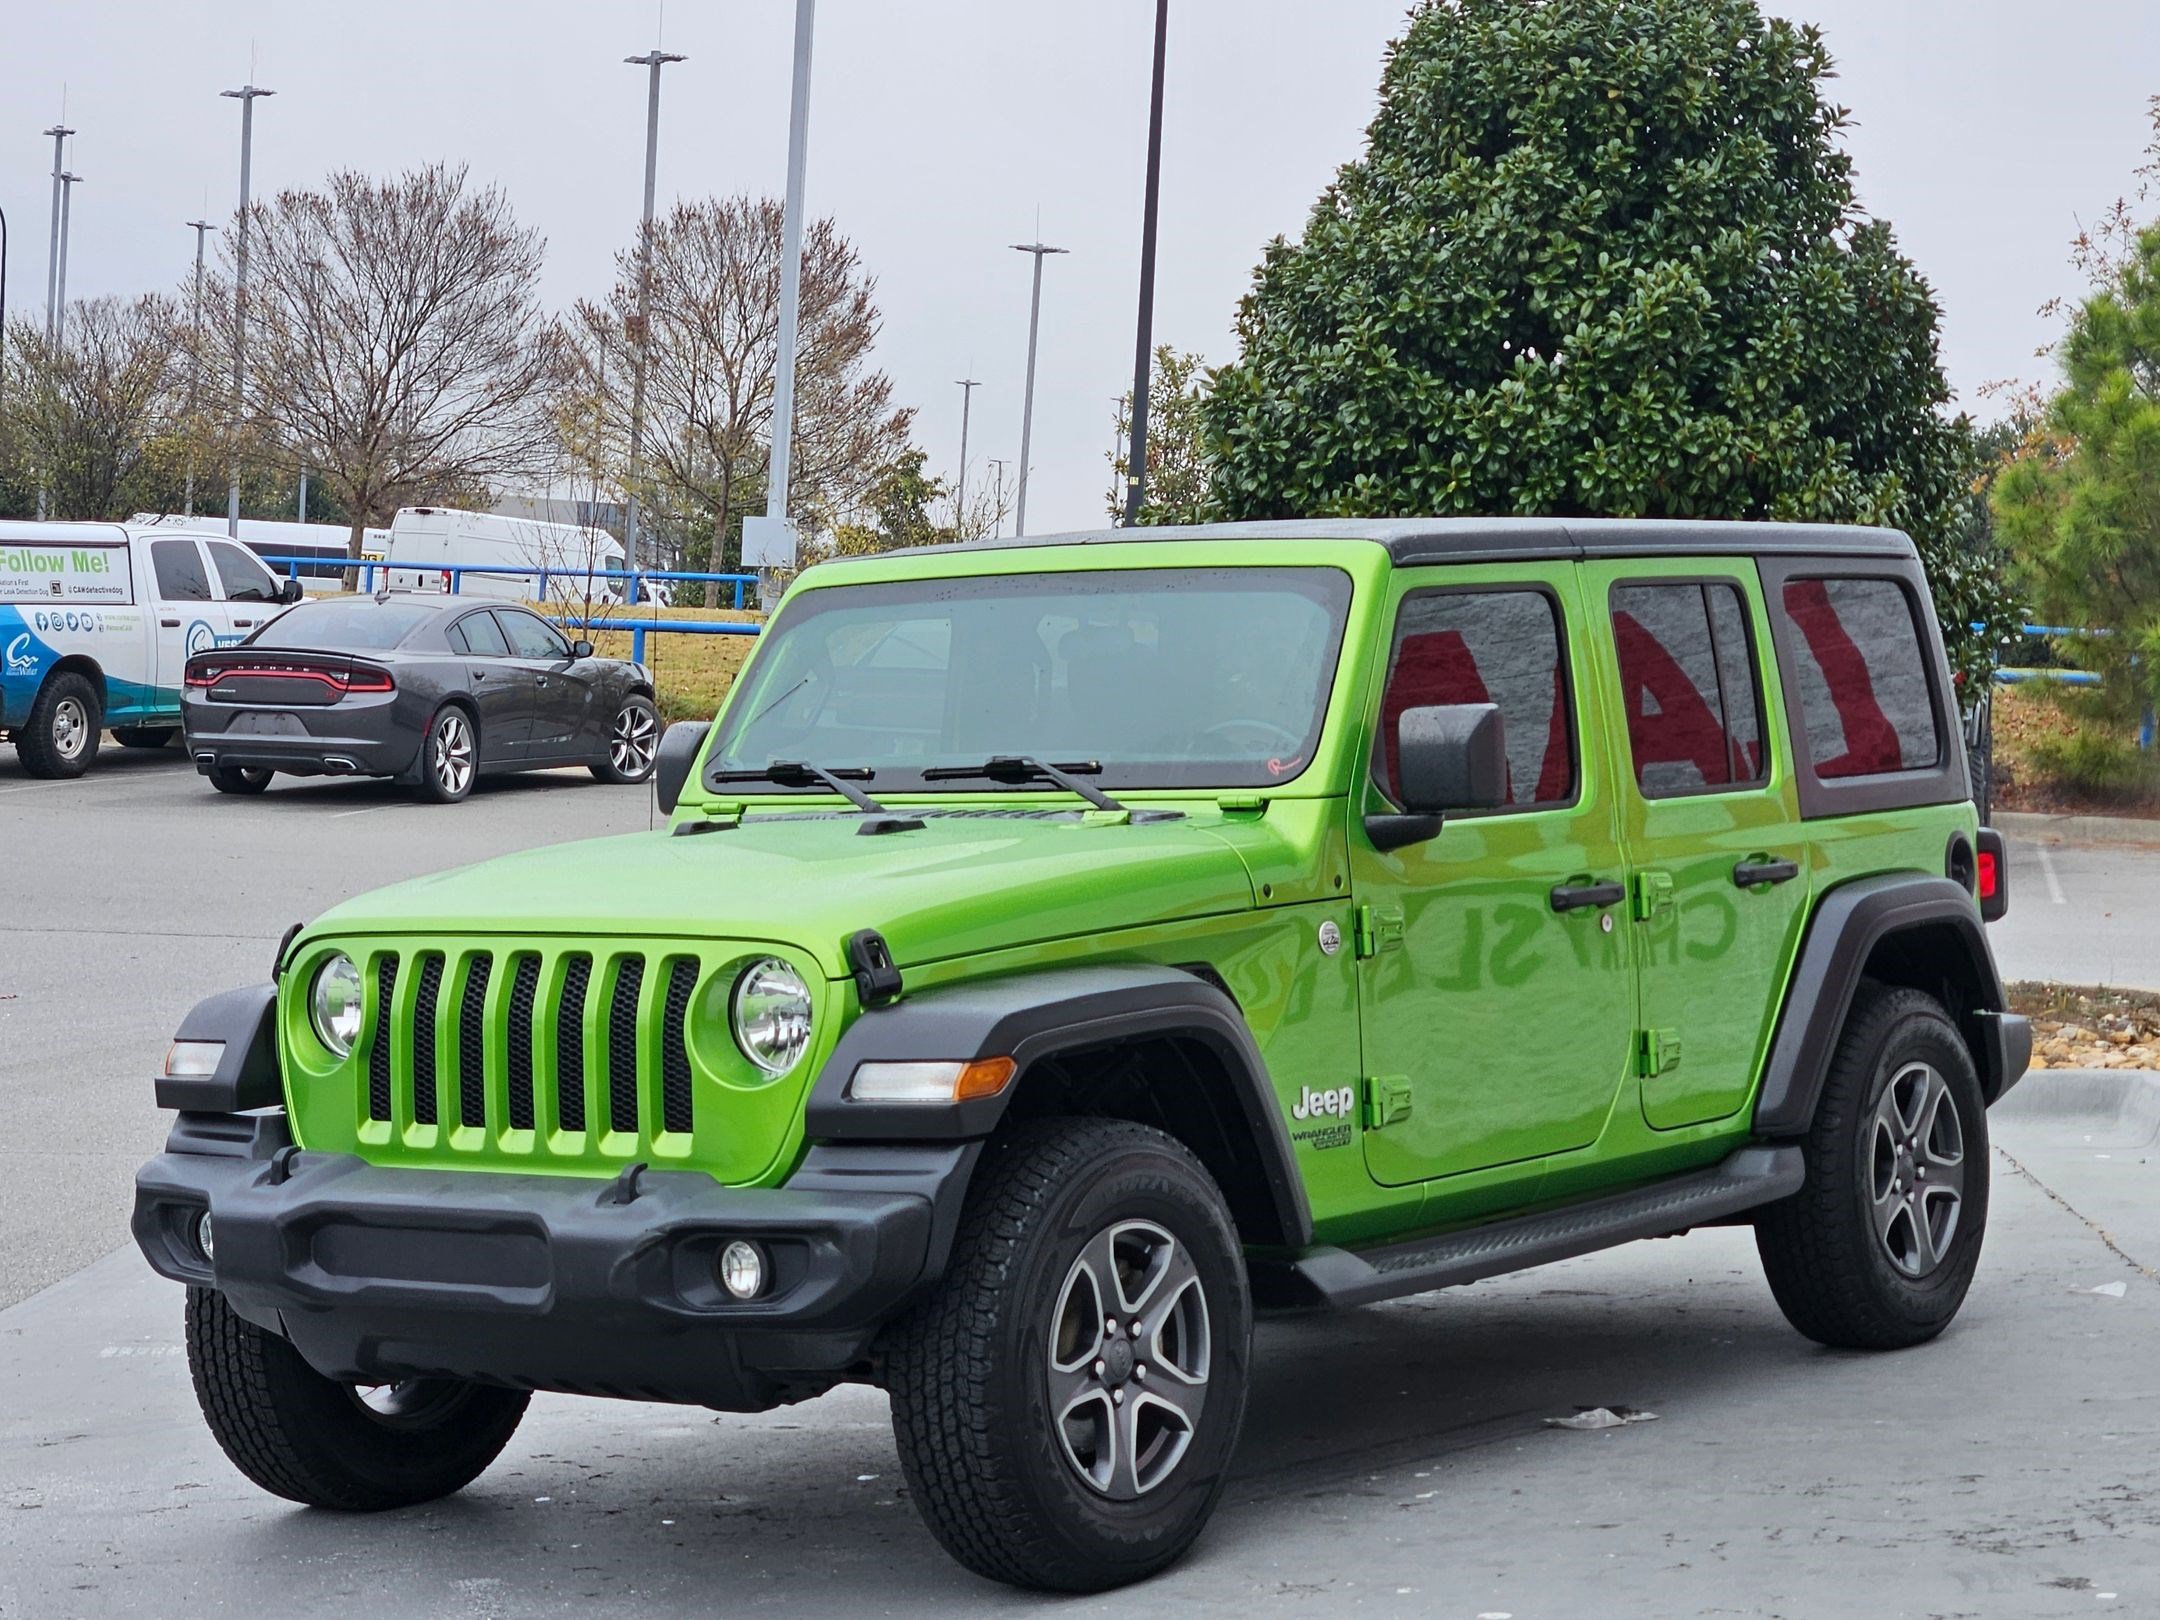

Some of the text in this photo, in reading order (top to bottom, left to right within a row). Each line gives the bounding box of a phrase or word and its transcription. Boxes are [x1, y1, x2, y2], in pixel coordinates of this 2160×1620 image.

[0, 549, 110, 573] Follow Me!
[1292, 1086, 1354, 1120] Jeep
[1292, 1123, 1351, 1141] WRANGLER
